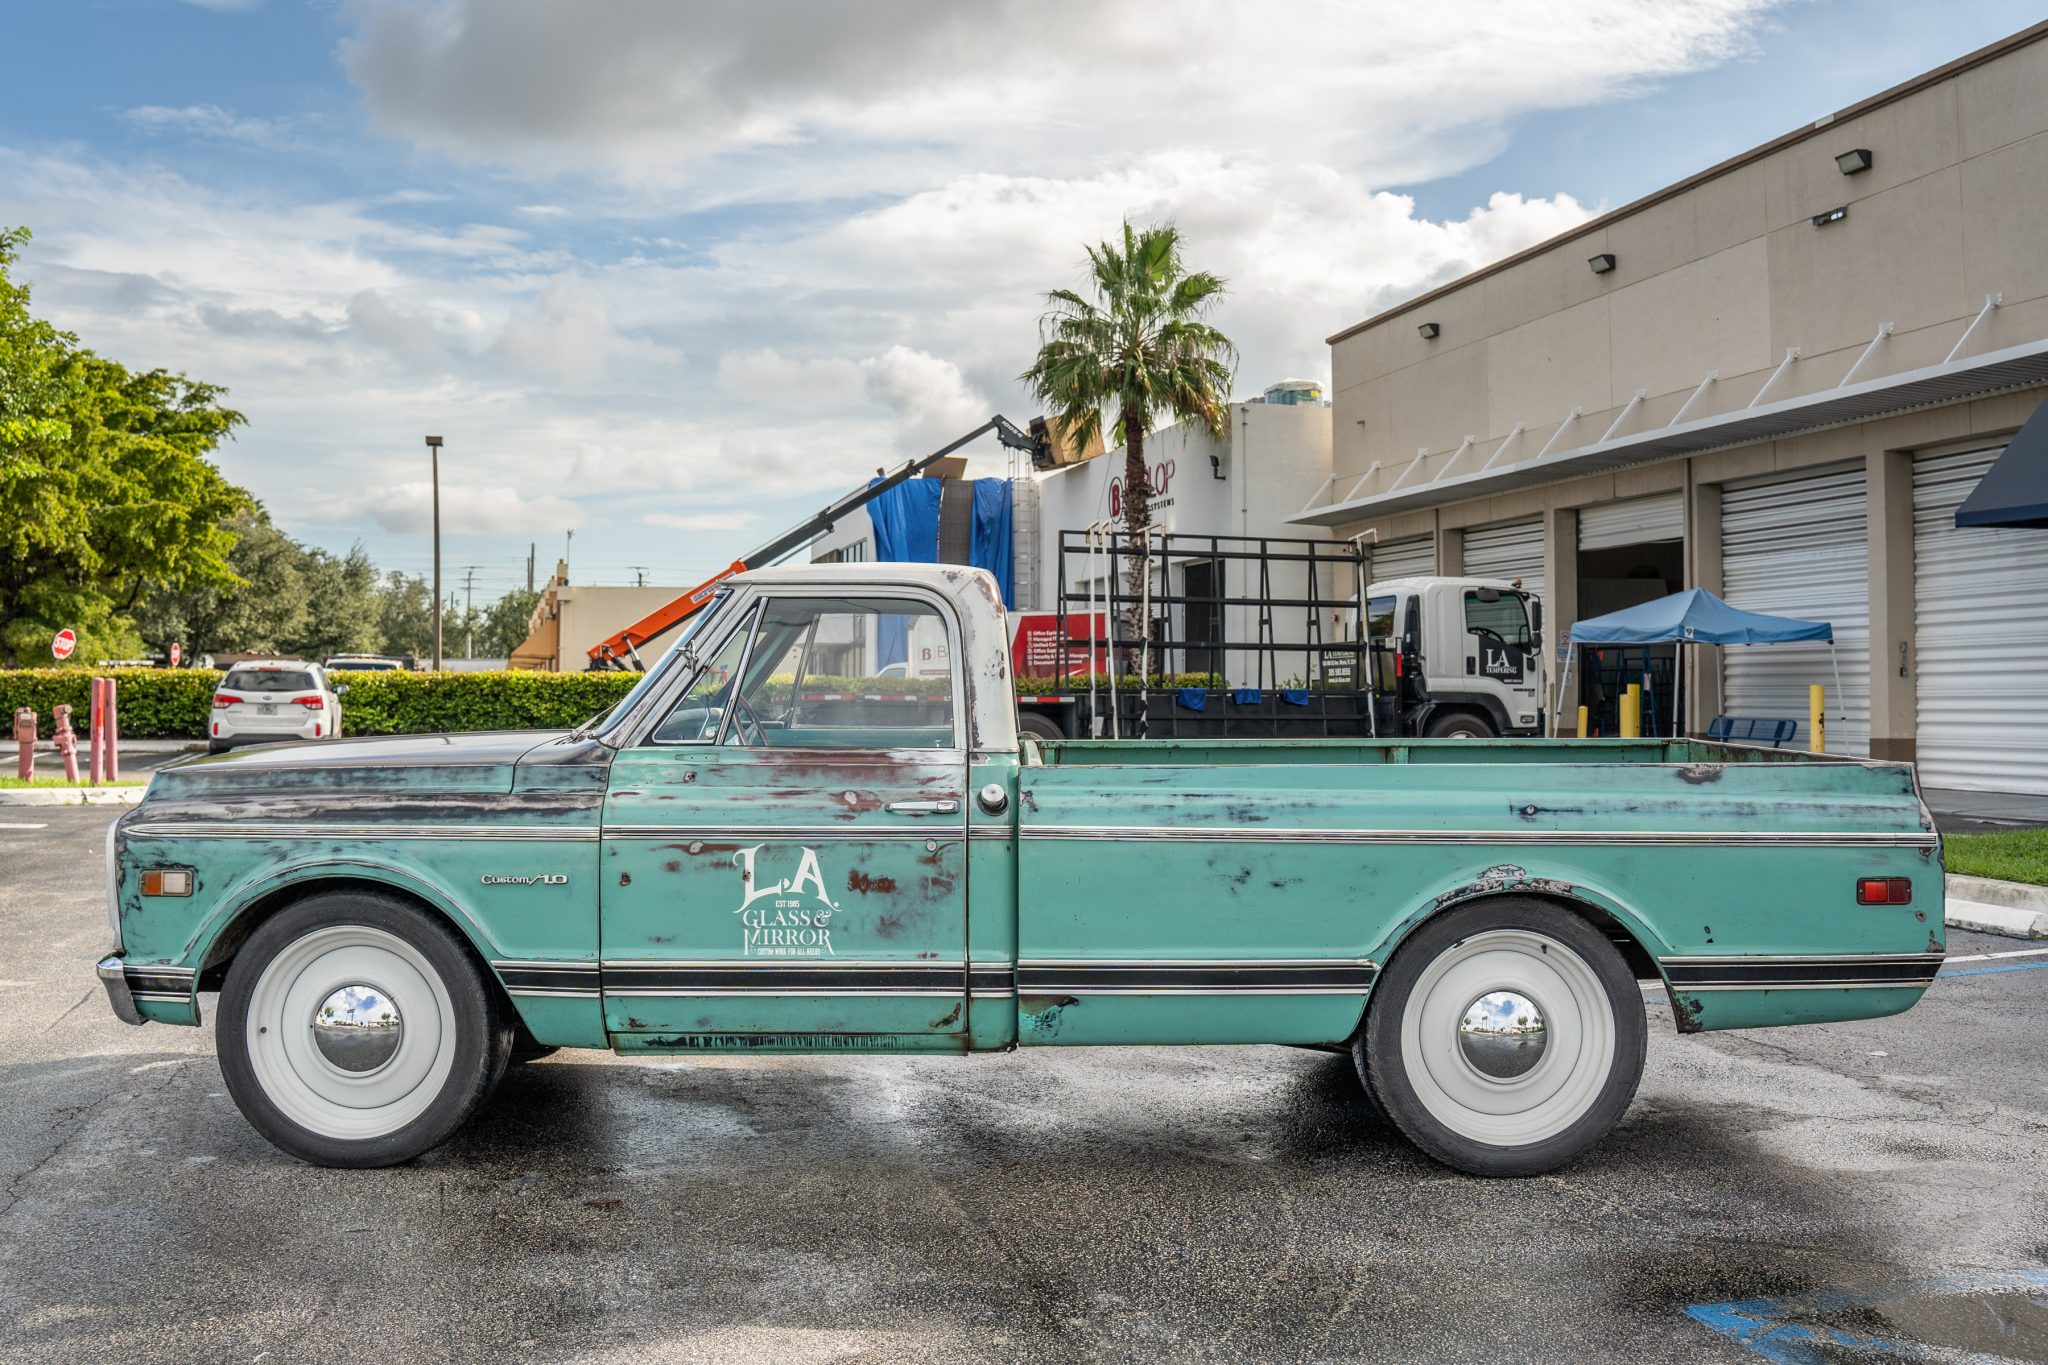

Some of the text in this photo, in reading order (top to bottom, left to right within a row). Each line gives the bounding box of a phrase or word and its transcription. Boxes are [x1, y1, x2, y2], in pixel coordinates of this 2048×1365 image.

[54, 636, 75, 651] STOP
[1485, 648, 1510, 667] LA
[743, 909, 832, 929] GLASS &
[743, 928, 835, 956] MIRROR
